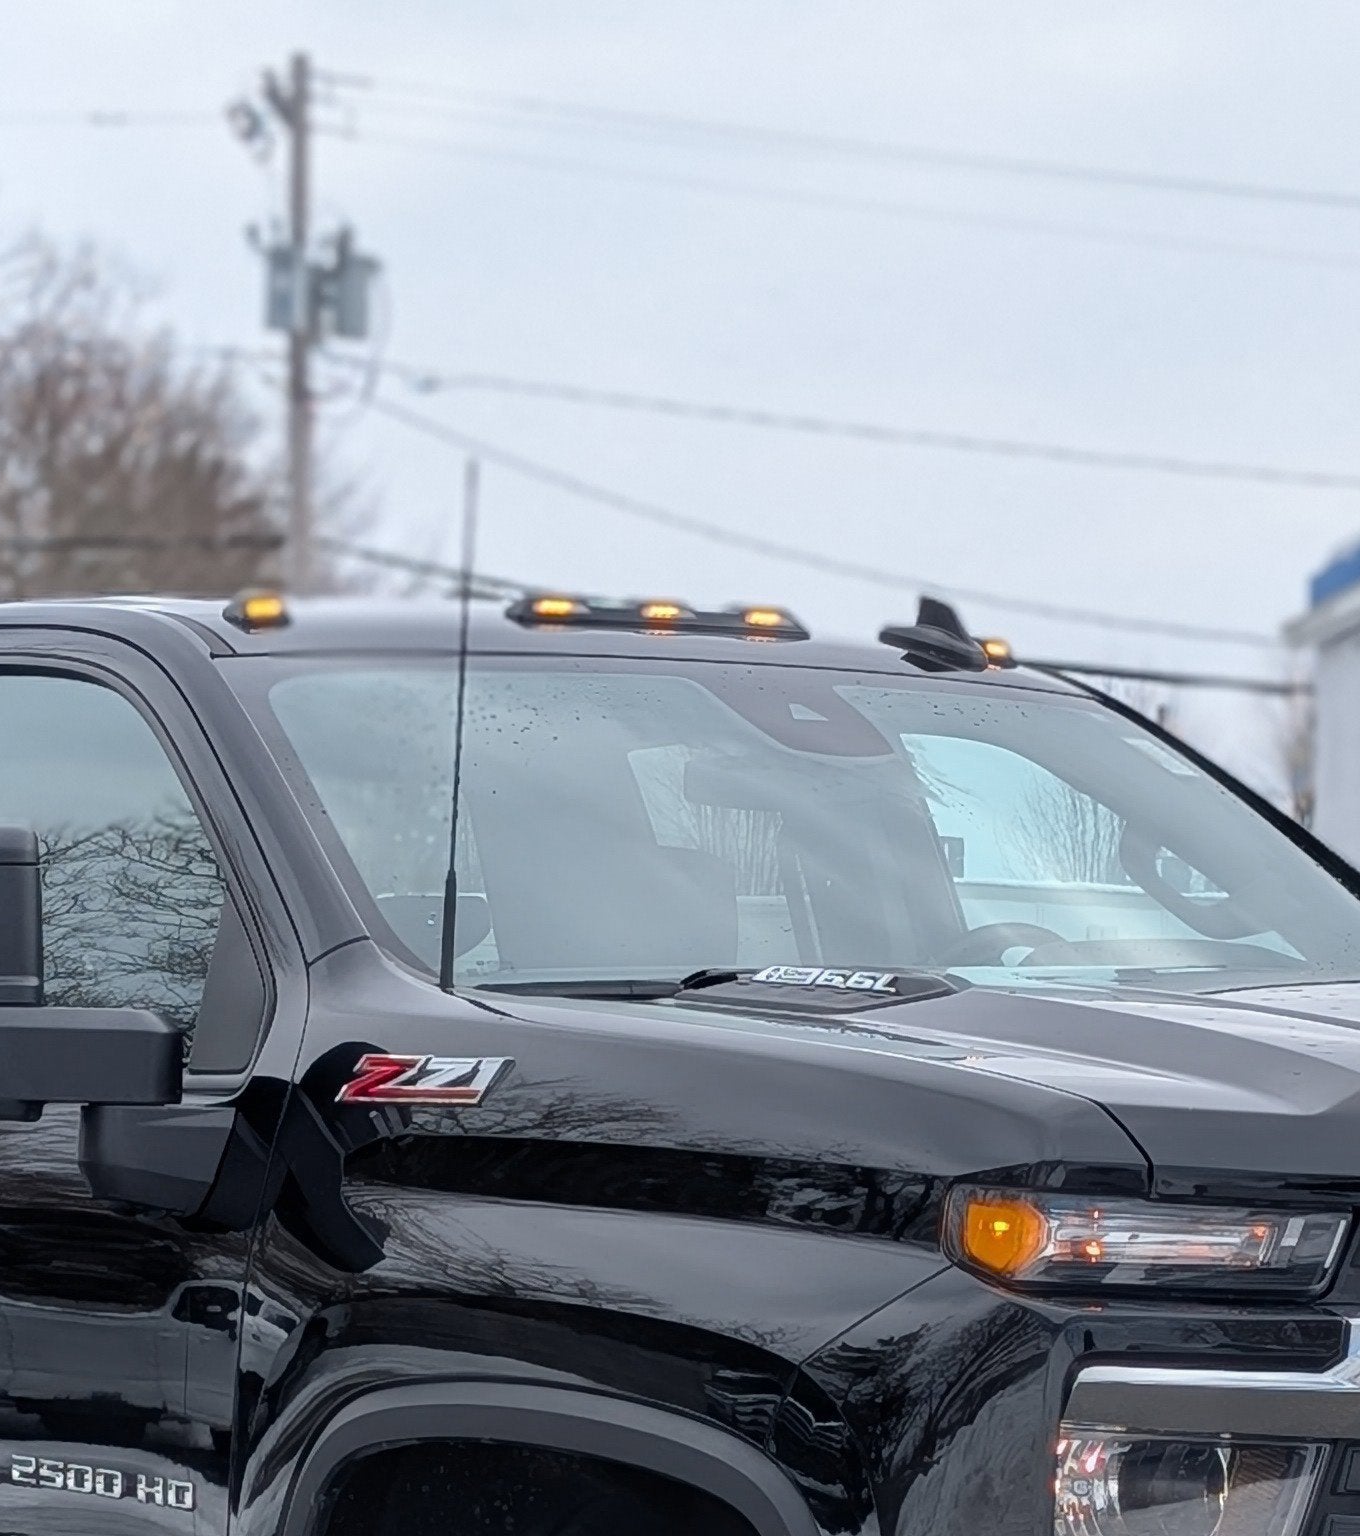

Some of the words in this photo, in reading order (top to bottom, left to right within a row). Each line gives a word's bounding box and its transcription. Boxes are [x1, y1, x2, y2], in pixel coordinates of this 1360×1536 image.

[813, 969, 897, 993] 6.6L
[334, 1053, 516, 1106] Z71
[11, 1453, 123, 1500] 2500
[136, 1473, 196, 1511] HD
